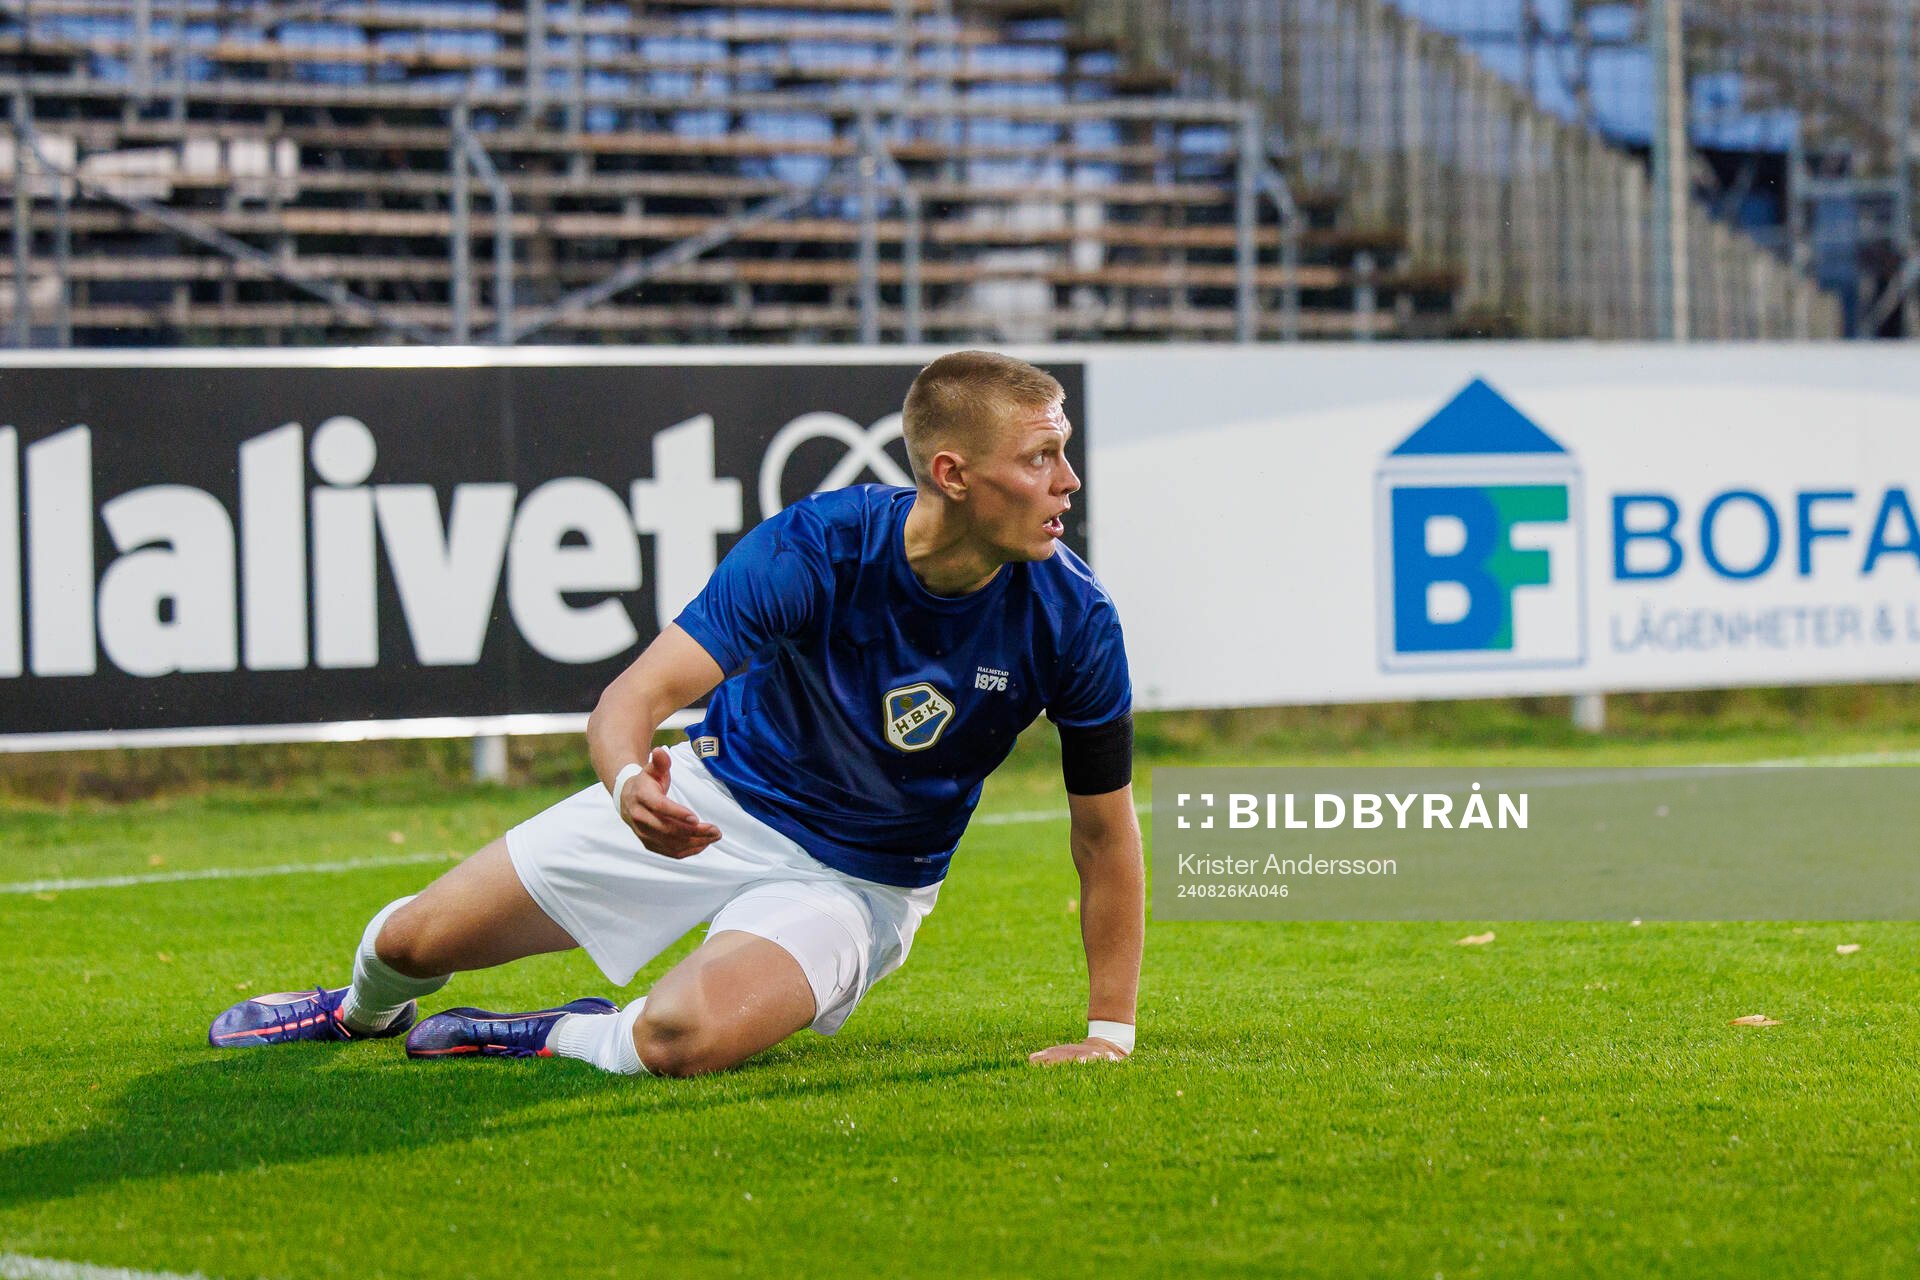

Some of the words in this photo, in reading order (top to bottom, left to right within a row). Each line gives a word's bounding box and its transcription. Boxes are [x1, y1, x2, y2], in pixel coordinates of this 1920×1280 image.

[1611, 488, 1920, 580] BOFA
[1391, 484, 1568, 653] BF
[975, 673, 1008, 691] 1976
[977, 666, 1009, 676] HALMSTAD
